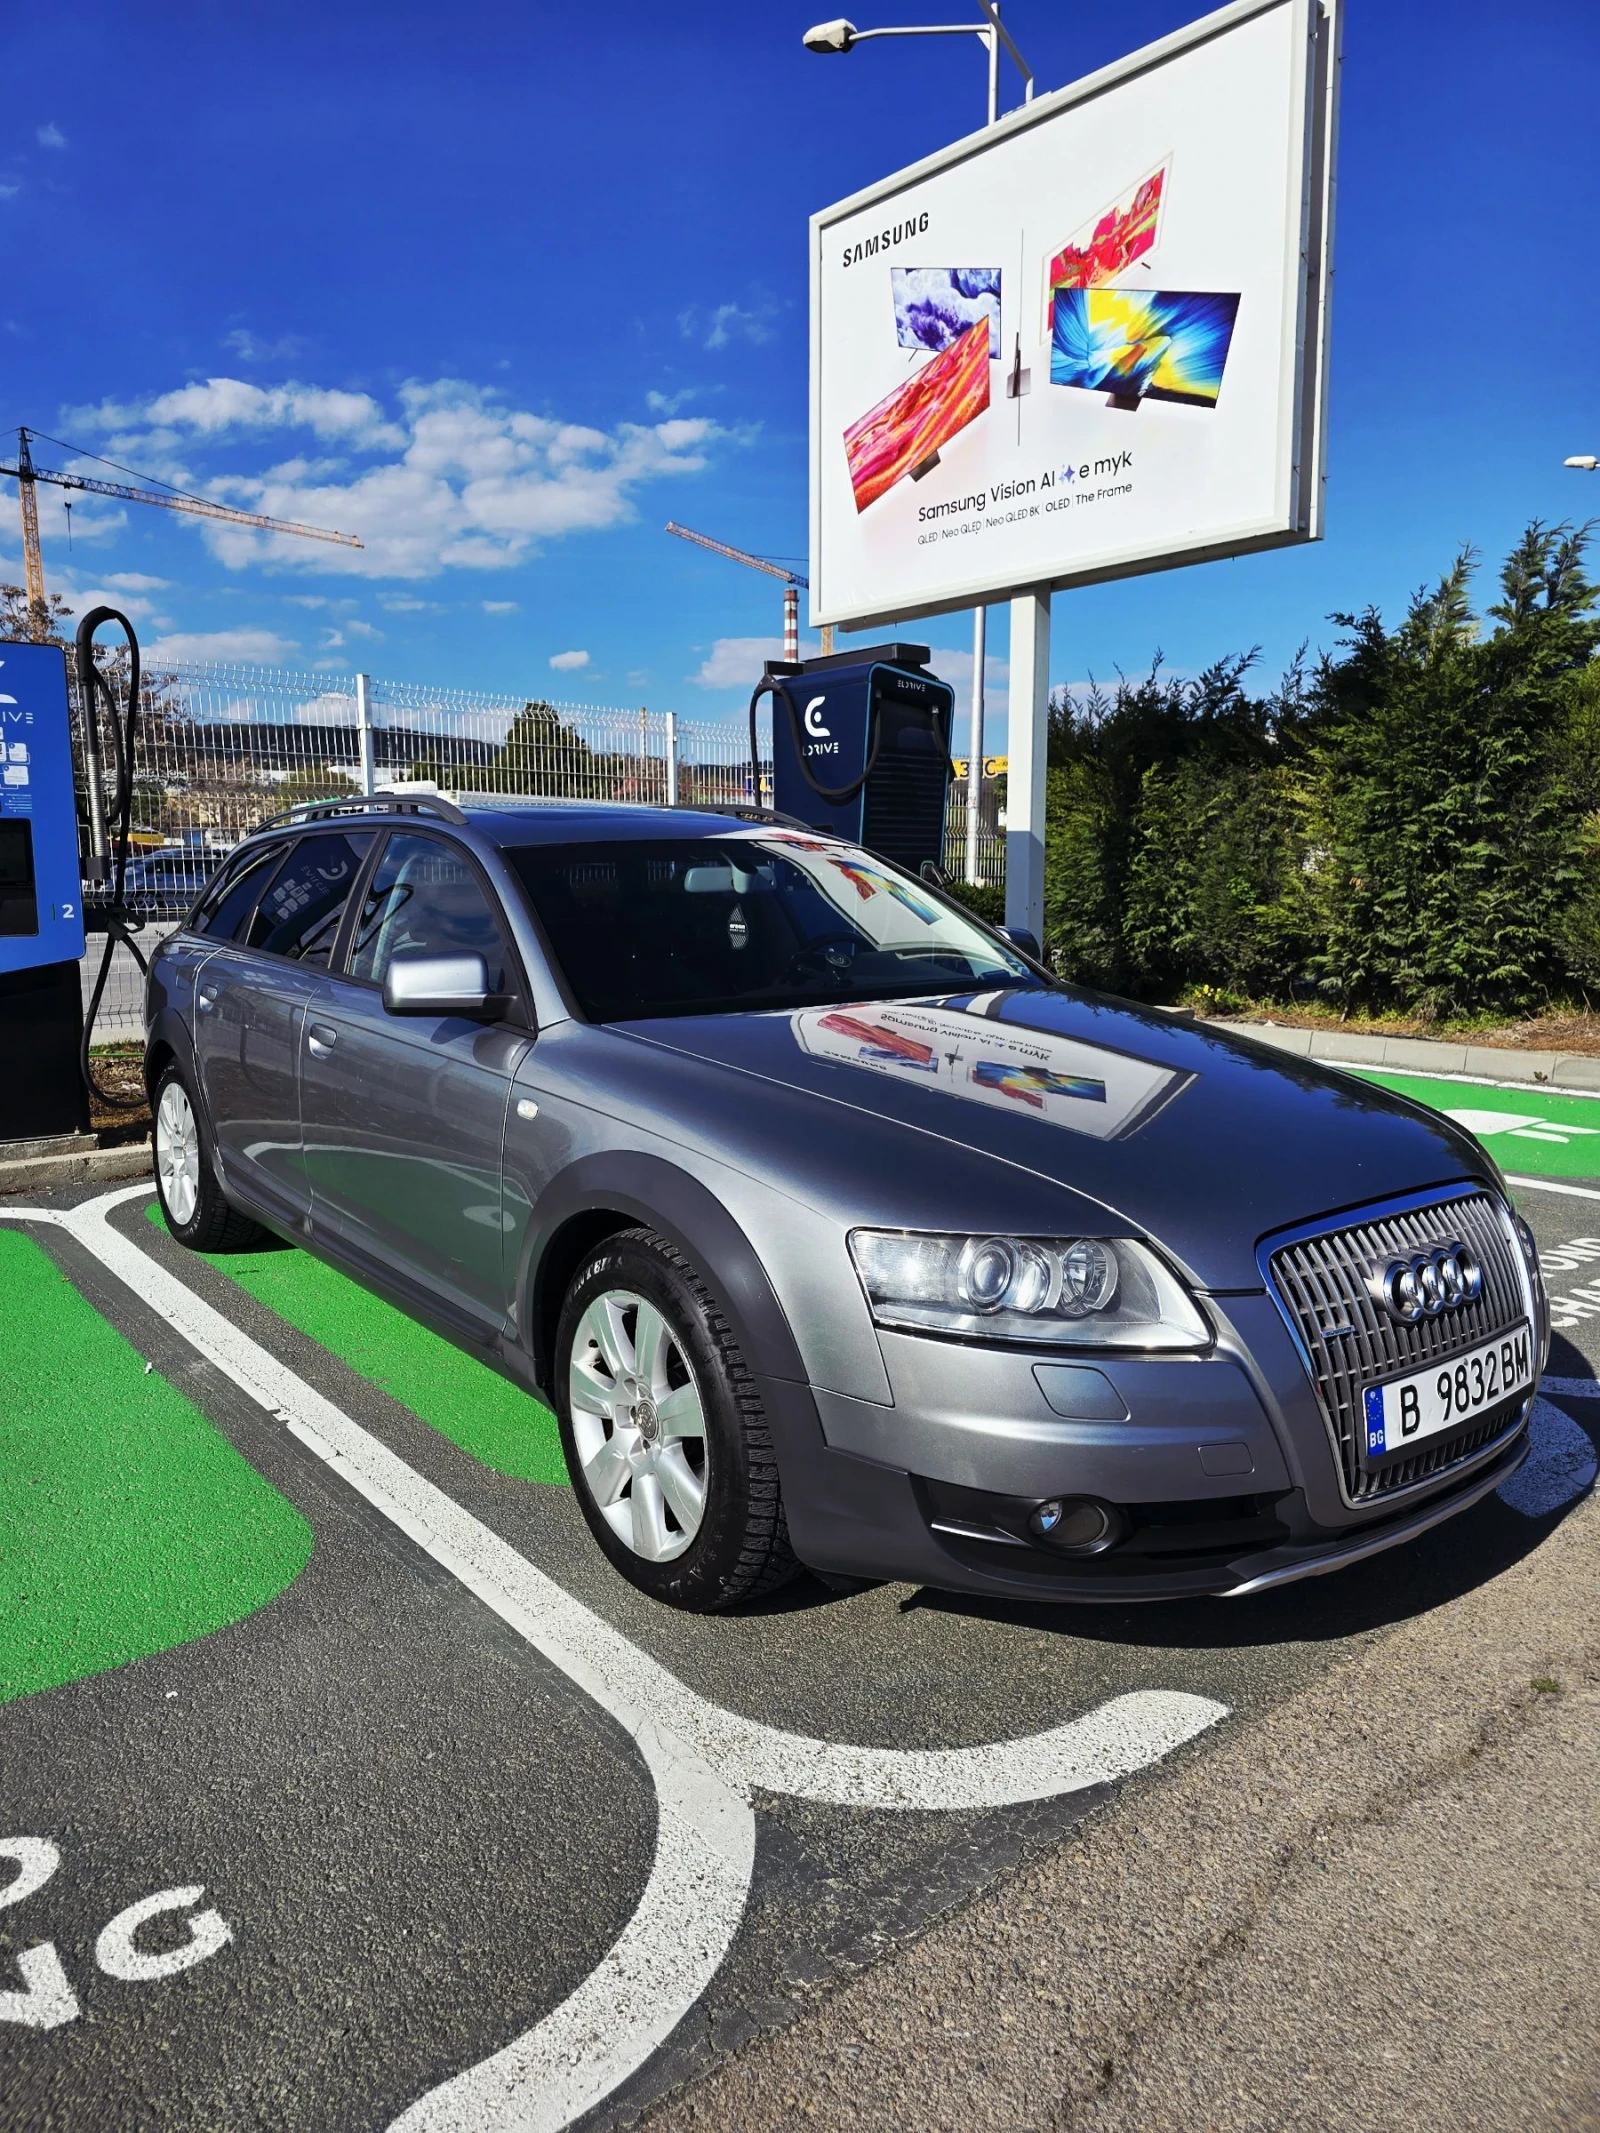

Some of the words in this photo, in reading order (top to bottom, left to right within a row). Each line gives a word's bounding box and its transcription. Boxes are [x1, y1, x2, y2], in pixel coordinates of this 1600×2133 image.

[843, 211, 930, 268] SAMSUNG
[917, 531, 938, 545] QLED
[941, 527, 959, 540] Neo
[960, 520, 982, 535] QLED
[985, 516, 1004, 528] Neo
[1005, 508, 1028, 523] QLED
[1029, 505, 1040, 517] 8K
[1045, 497, 1071, 513] OLED
[1075, 491, 1095, 506] The
[1097, 482, 1133, 500] Frame
[918, 492, 986, 522] Samsung
[991, 479, 1036, 502] Vision
[1040, 470, 1055, 490] AI
[62, 904, 75, 919] 2
[1400, 1384, 1421, 1437] B
[1369, 1429, 1384, 1448] BG
